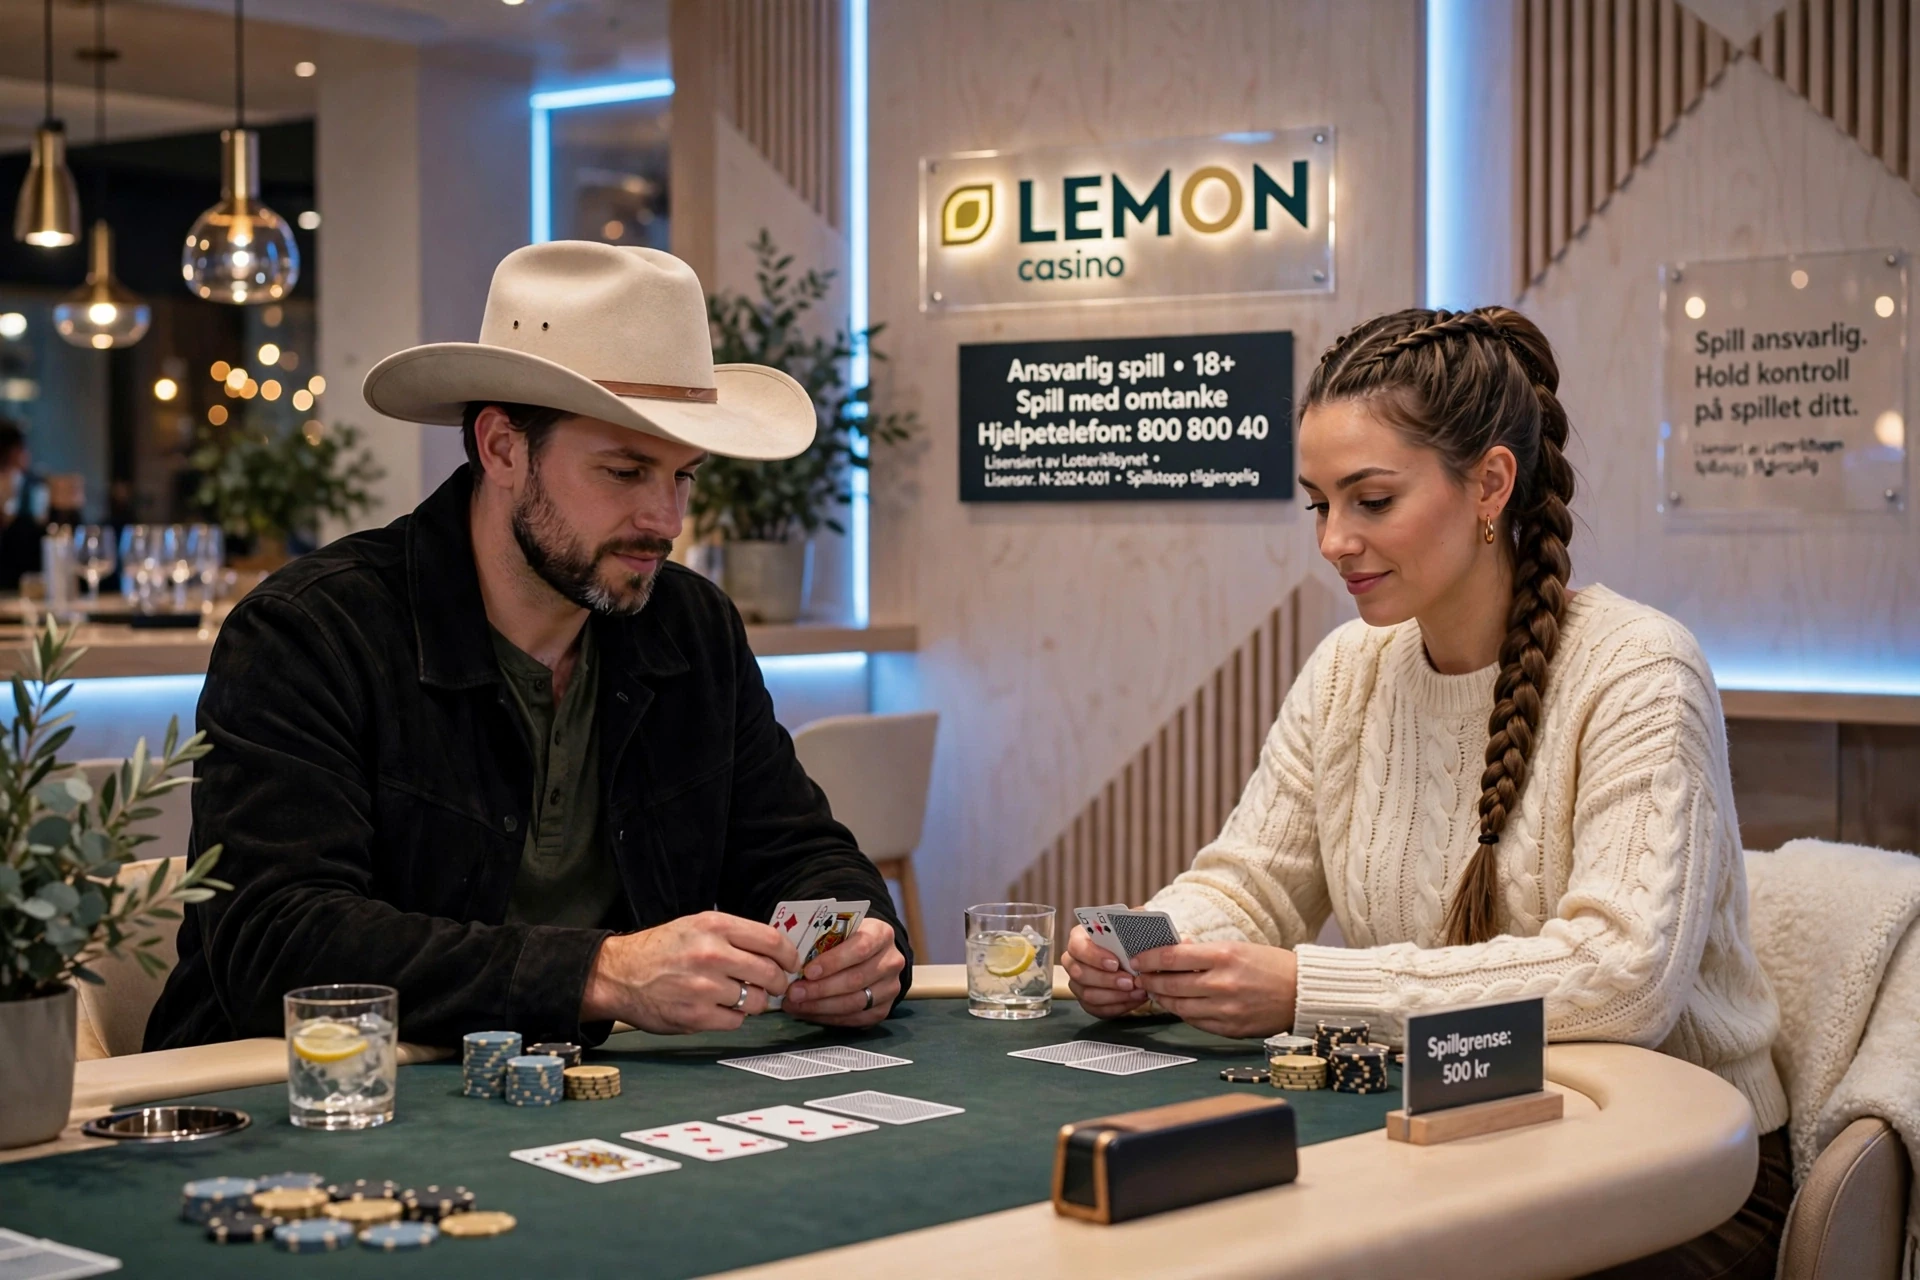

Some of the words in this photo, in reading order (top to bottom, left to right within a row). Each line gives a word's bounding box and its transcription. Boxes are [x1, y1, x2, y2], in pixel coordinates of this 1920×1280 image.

[1018, 160, 1309, 244] LEMON
[1018, 249, 1125, 282] casino
[1695, 328, 1745, 359] Spill
[1751, 322, 1868, 354] ansvarlig.
[1007, 355, 1114, 386] Ansvarlig
[1118, 352, 1166, 384] spill
[1193, 351, 1236, 377] 18+
[1695, 362, 1750, 388] Hold
[1756, 357, 1850, 384] kontroll
[1016, 387, 1064, 419] Spill
[1069, 385, 1120, 411] med
[1124, 383, 1229, 412] omtanke
[1694, 397, 1724, 426] på
[1730, 396, 1803, 425] spillet
[1808, 392, 1859, 417] ditt.
[978, 418, 1133, 451] Hjelpetelefon:
[1137, 417, 1182, 442] 800
[1186, 416, 1233, 441] 800
[1236, 415, 1270, 440] 40
[1427, 1030, 1512, 1062] Spillgrense:
[1442, 1060, 1472, 1085] 500
[1474, 1058, 1491, 1079] kr
